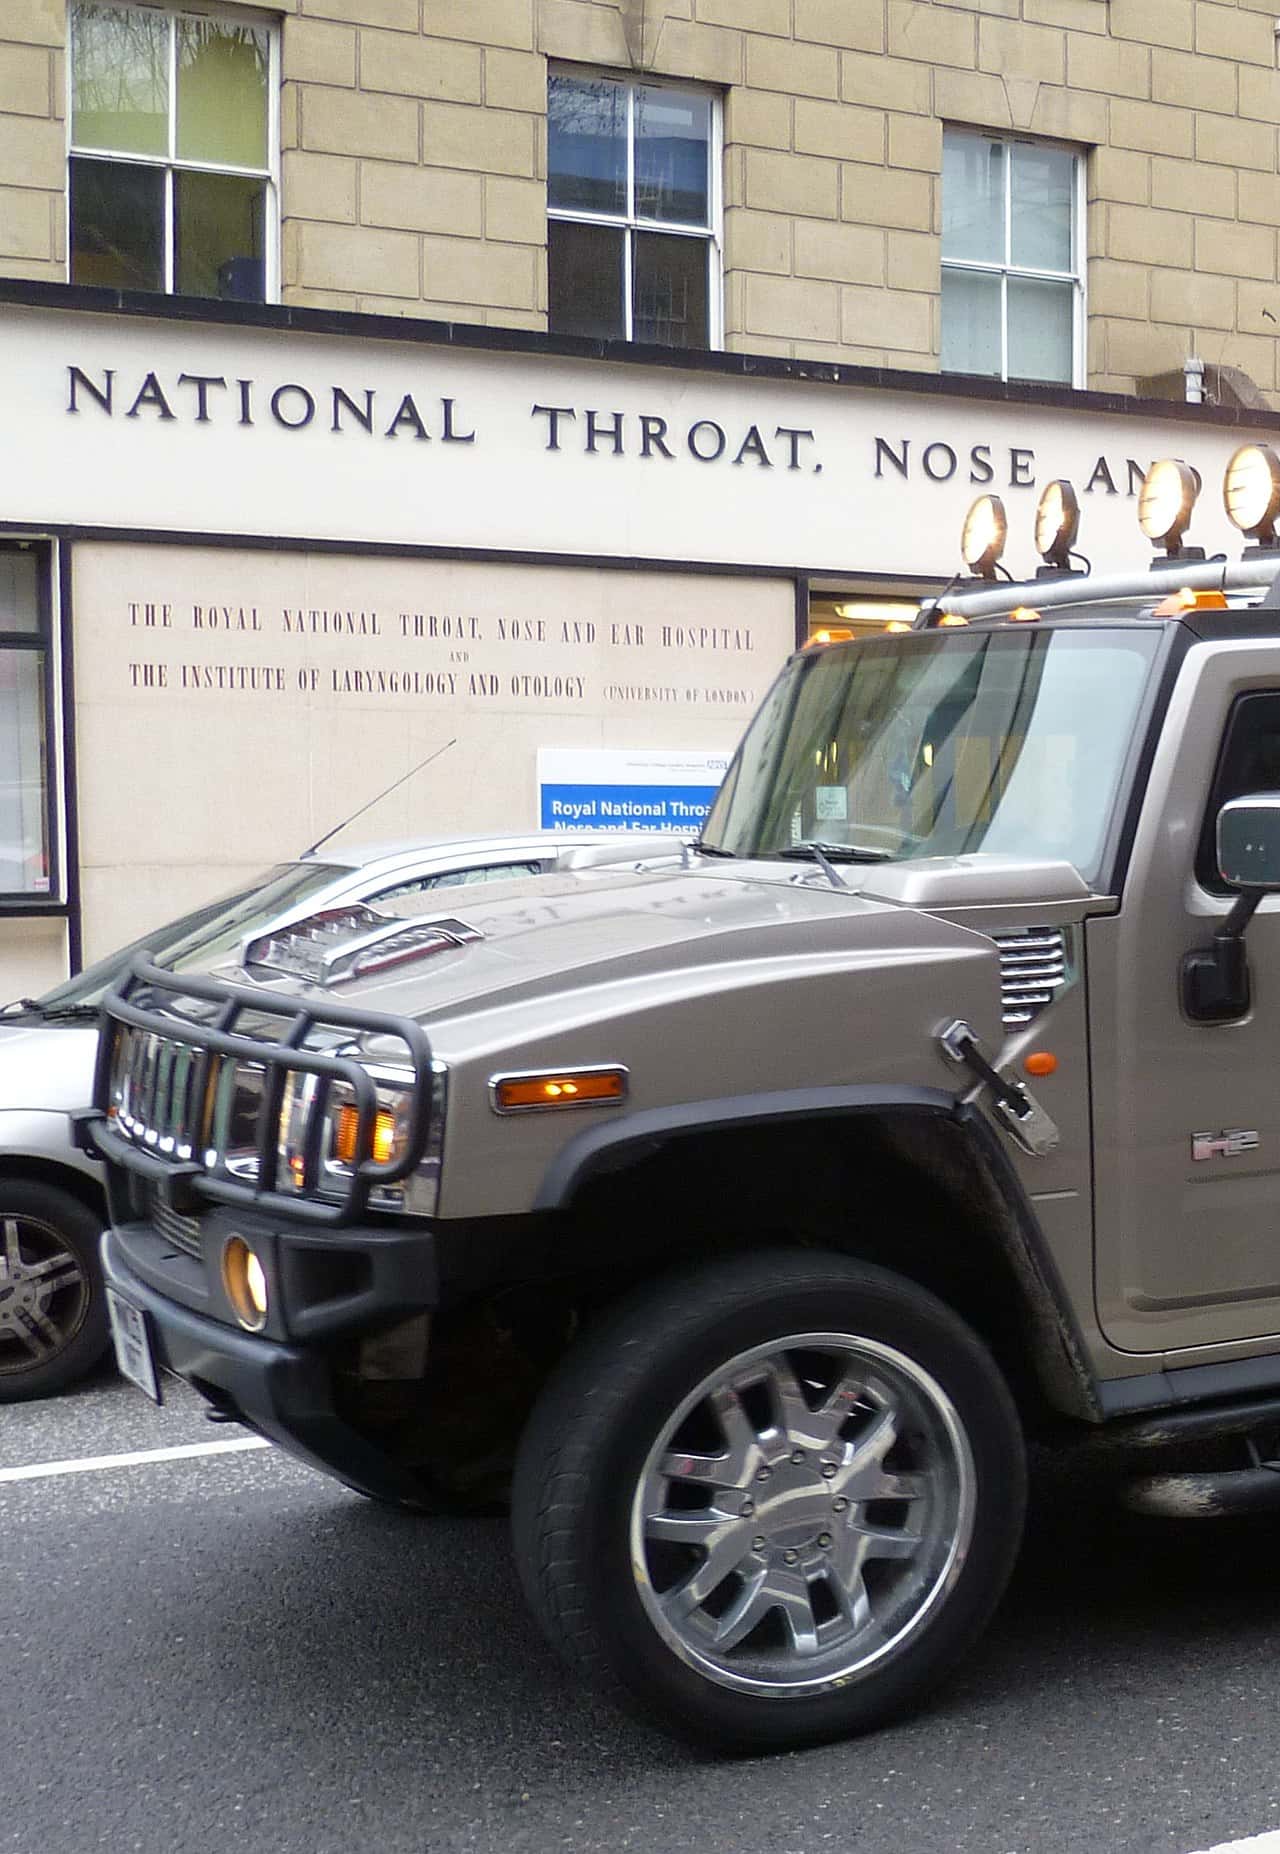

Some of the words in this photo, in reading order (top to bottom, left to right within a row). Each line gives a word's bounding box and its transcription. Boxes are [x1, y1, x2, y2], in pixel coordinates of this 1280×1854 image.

[66, 364, 475, 443] NATIONAL
[873, 436, 1037, 488] NOSE
[128, 603, 172, 627] THE
[192, 605, 262, 631] ROYAL
[282, 609, 381, 635] NATIONAL
[497, 617, 546, 642] NOSE
[561, 621, 597, 644] AND
[611, 623, 645, 646] EAR
[661, 626, 754, 651] HOSPITAL
[449, 651, 470, 663] AND
[129, 664, 167, 688] THE
[181, 665, 286, 690] INSTITUTE
[298, 668, 320, 691] OF
[331, 669, 457, 696] LARYNGOLOGY
[468, 673, 499, 697] AND
[511, 675, 586, 698] OTOLOGY
[686, 688, 698, 702] OF
[552, 801, 596, 820] Royal
[601, 801, 666, 817] National
[669, 802, 712, 817] Throa
